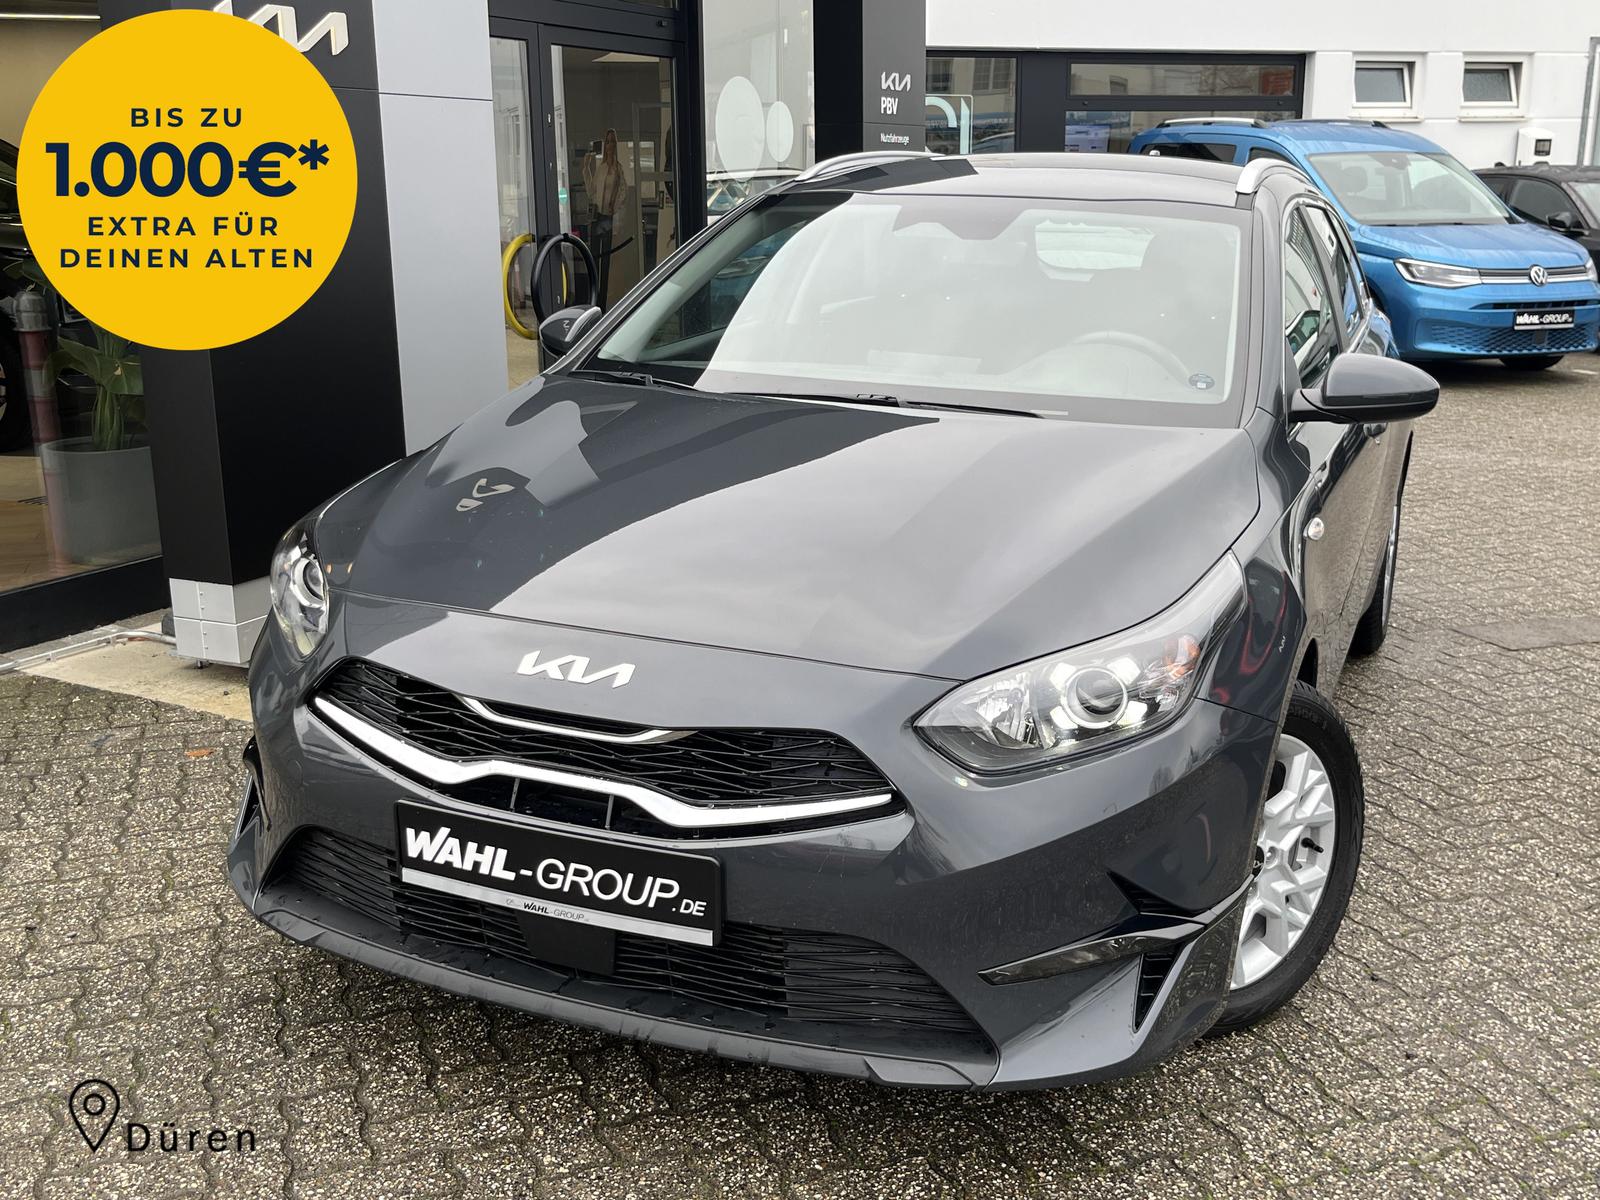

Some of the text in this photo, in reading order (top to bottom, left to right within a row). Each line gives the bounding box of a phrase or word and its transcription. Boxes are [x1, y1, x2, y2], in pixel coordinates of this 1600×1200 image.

[881, 71, 912, 92] KIA
[880, 96, 899, 115] PBV
[880, 132, 910, 146] Nutzfahrzeuge
[516, 650, 636, 689] KIA
